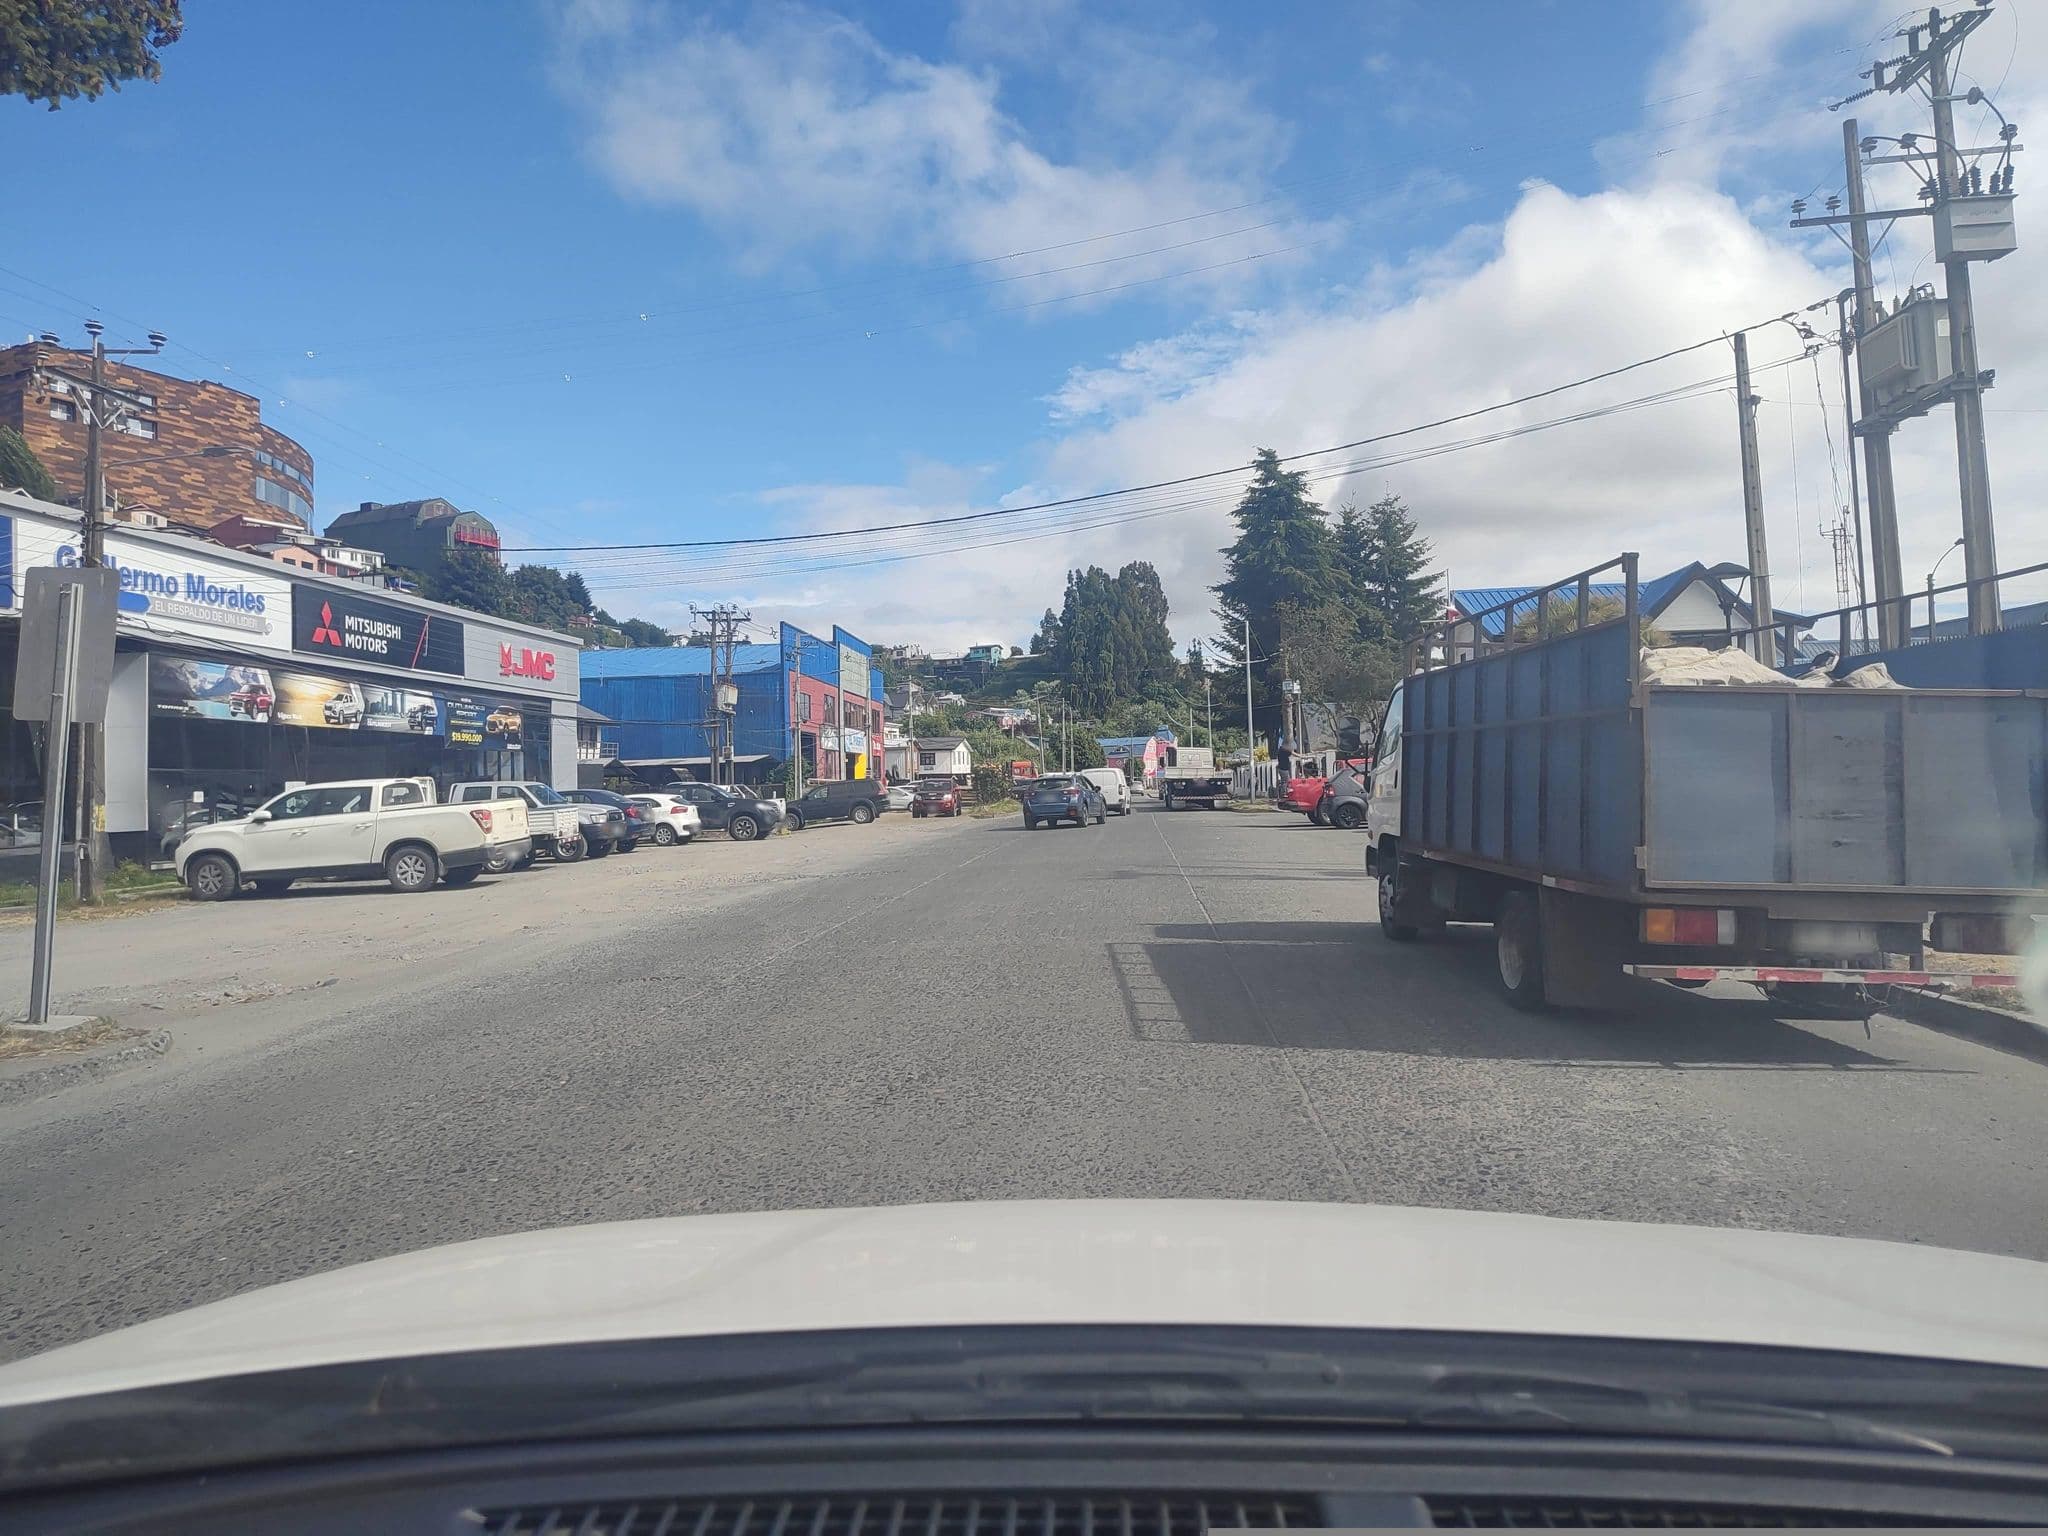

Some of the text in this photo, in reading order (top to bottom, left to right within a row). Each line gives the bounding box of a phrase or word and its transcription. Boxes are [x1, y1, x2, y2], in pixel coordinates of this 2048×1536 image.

[187, 572, 266, 614] Morales
[155, 600, 166, 612] EL
[168, 603, 211, 620] RESPALDO
[212, 610, 223, 623] DE
[224, 613, 236, 625] UN
[345, 615, 401, 640] MITSUBISHI
[345, 634, 388, 654] MOTORS
[513, 647, 555, 680] JMC
